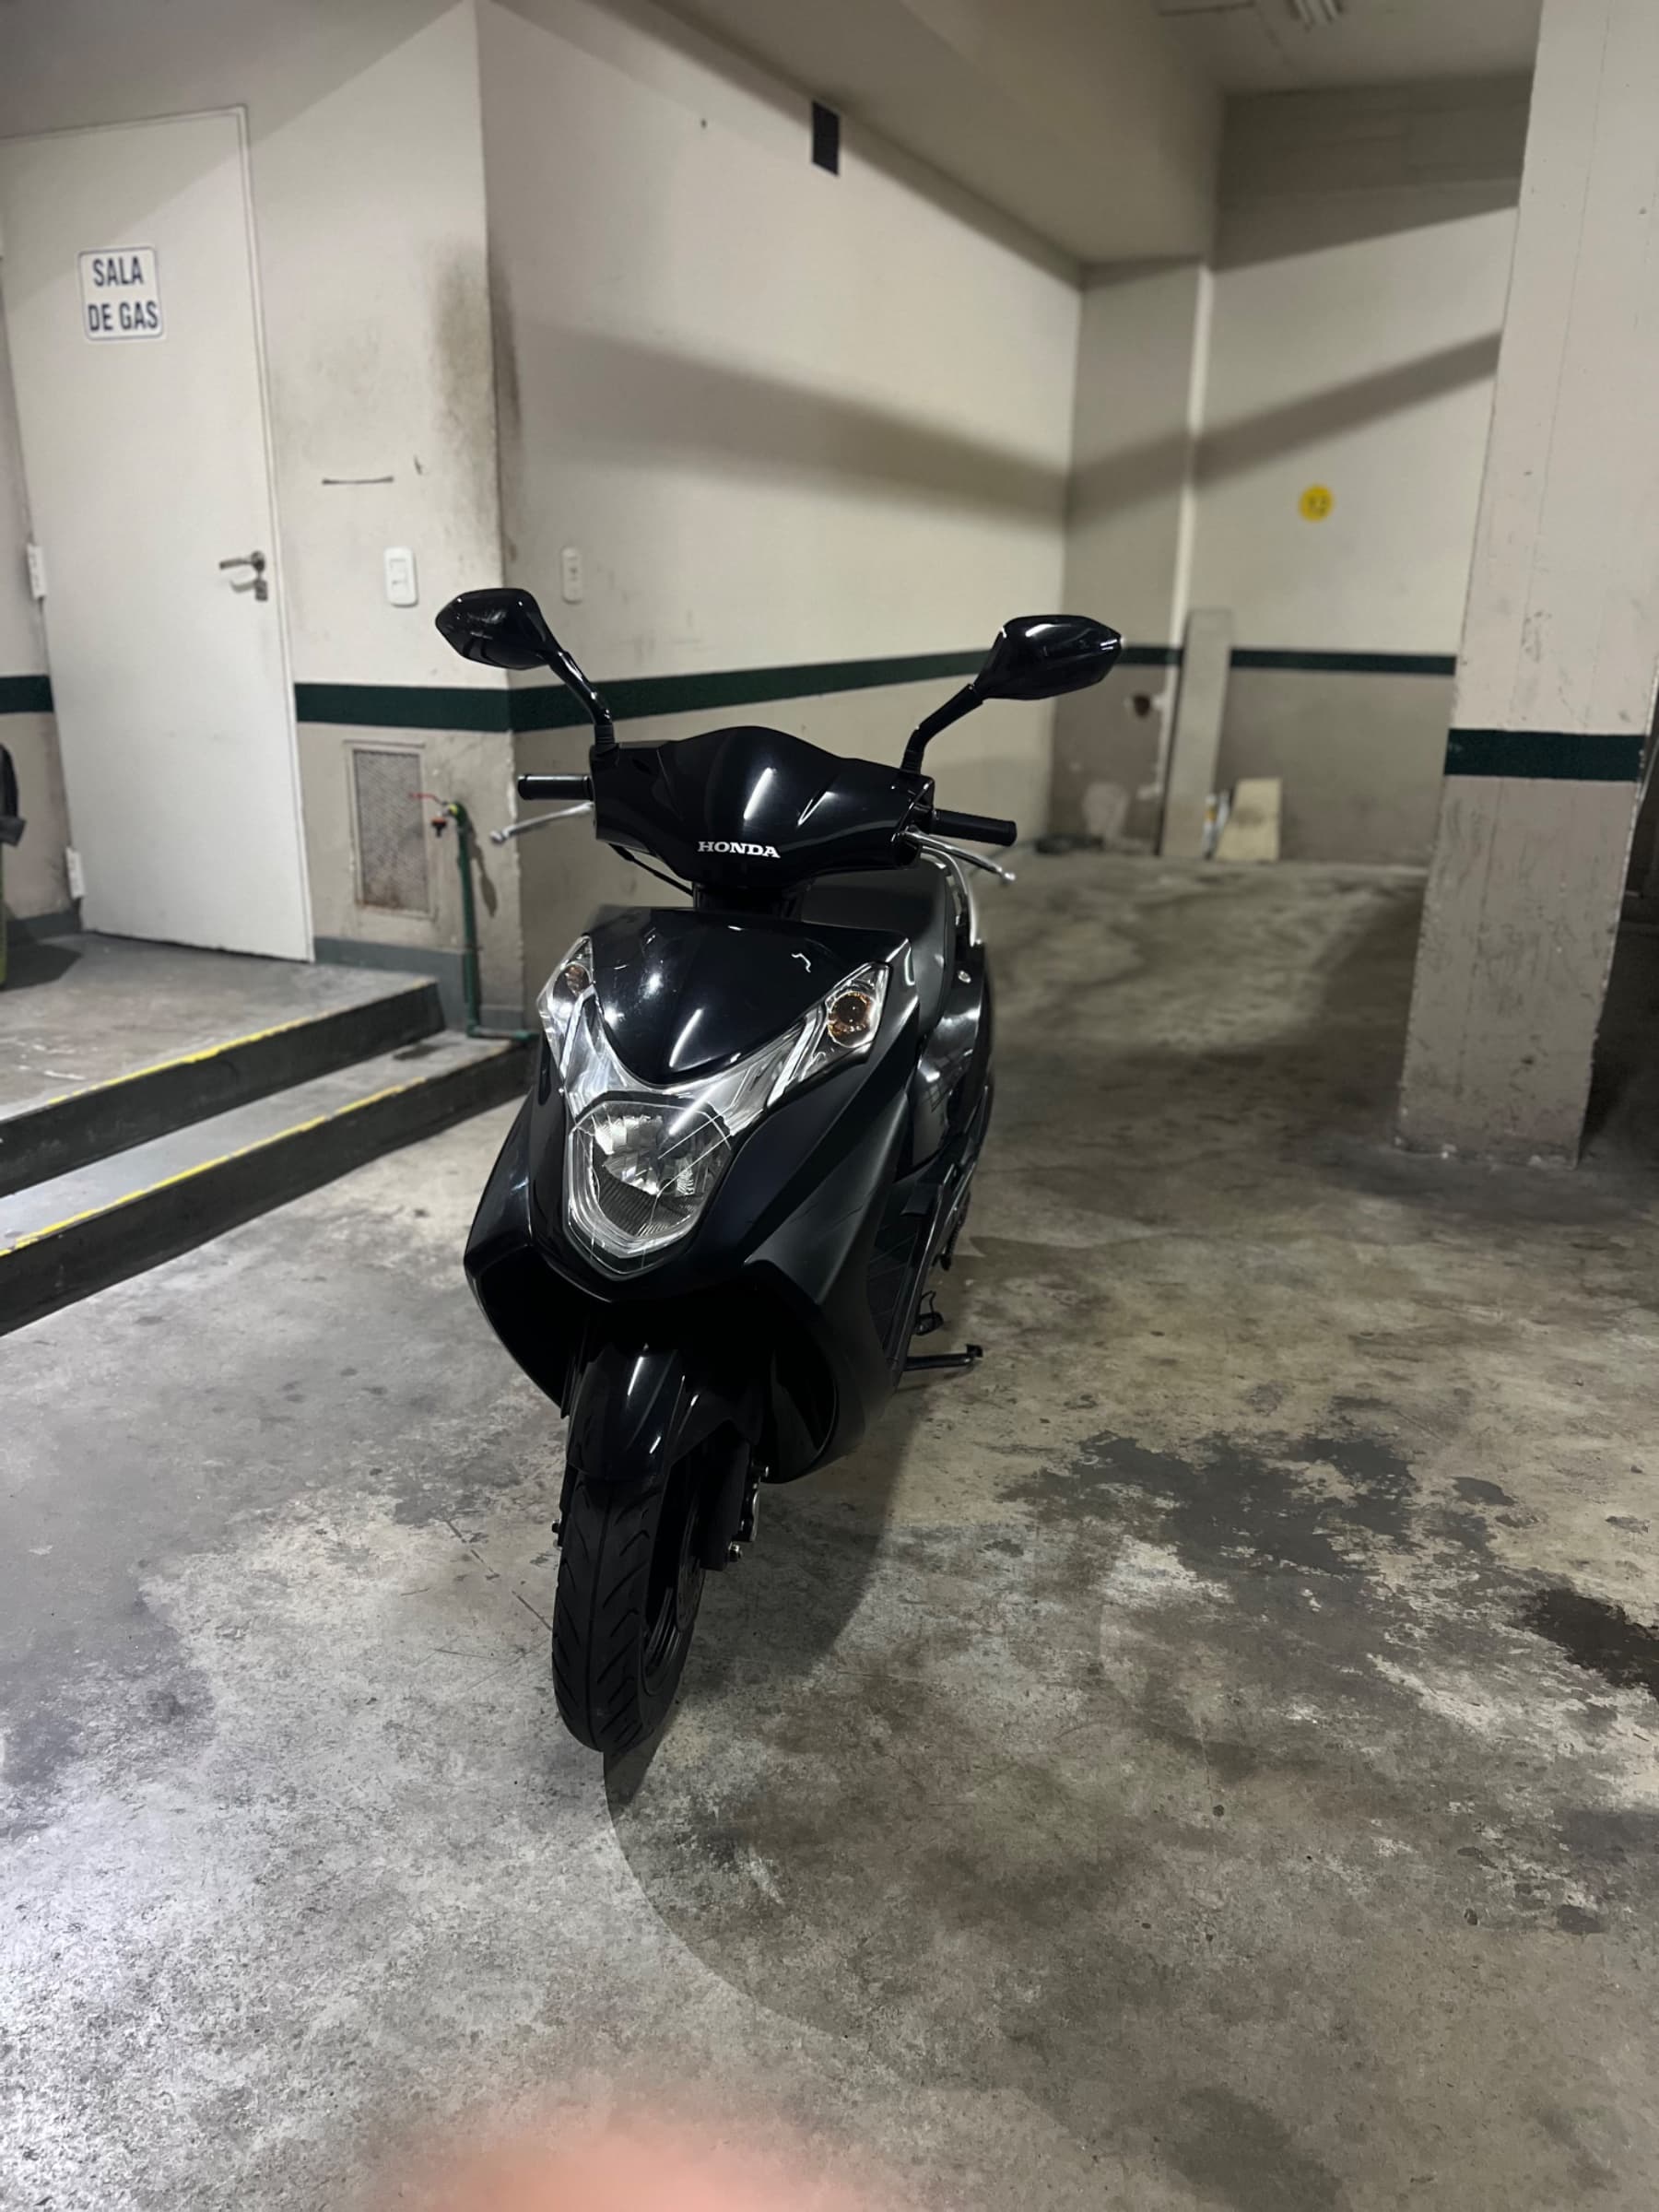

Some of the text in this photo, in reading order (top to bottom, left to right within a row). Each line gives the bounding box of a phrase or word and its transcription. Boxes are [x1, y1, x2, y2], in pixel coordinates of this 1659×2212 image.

[92, 255, 144, 288] SALA
[88, 300, 159, 331] DE GAS
[697, 841, 782, 859] HONDA
